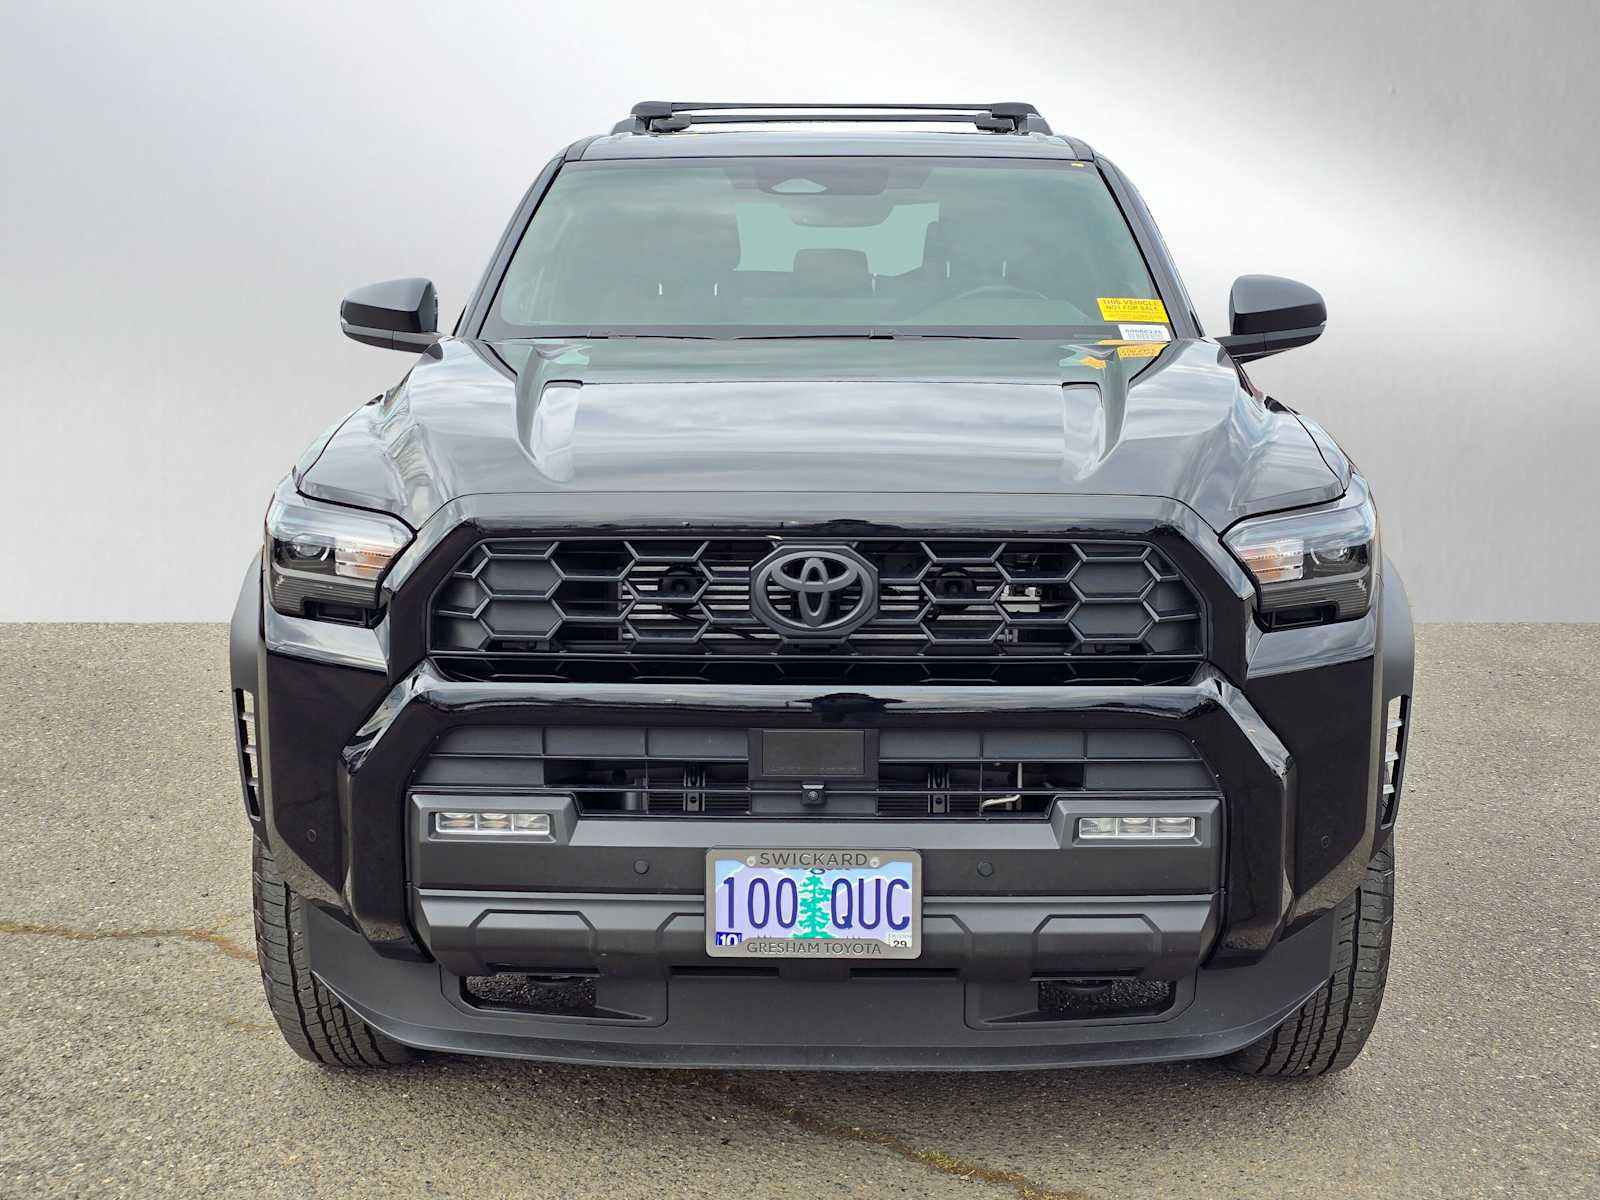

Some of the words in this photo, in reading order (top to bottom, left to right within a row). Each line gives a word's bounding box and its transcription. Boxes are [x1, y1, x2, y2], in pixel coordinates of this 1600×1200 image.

[760, 853, 867, 866] SWICKARD
[723, 877, 798, 929] 100
[831, 878, 910, 930] QUC
[746, 942, 822, 953] GRESHAM
[824, 943, 881, 954] TOYOTA
